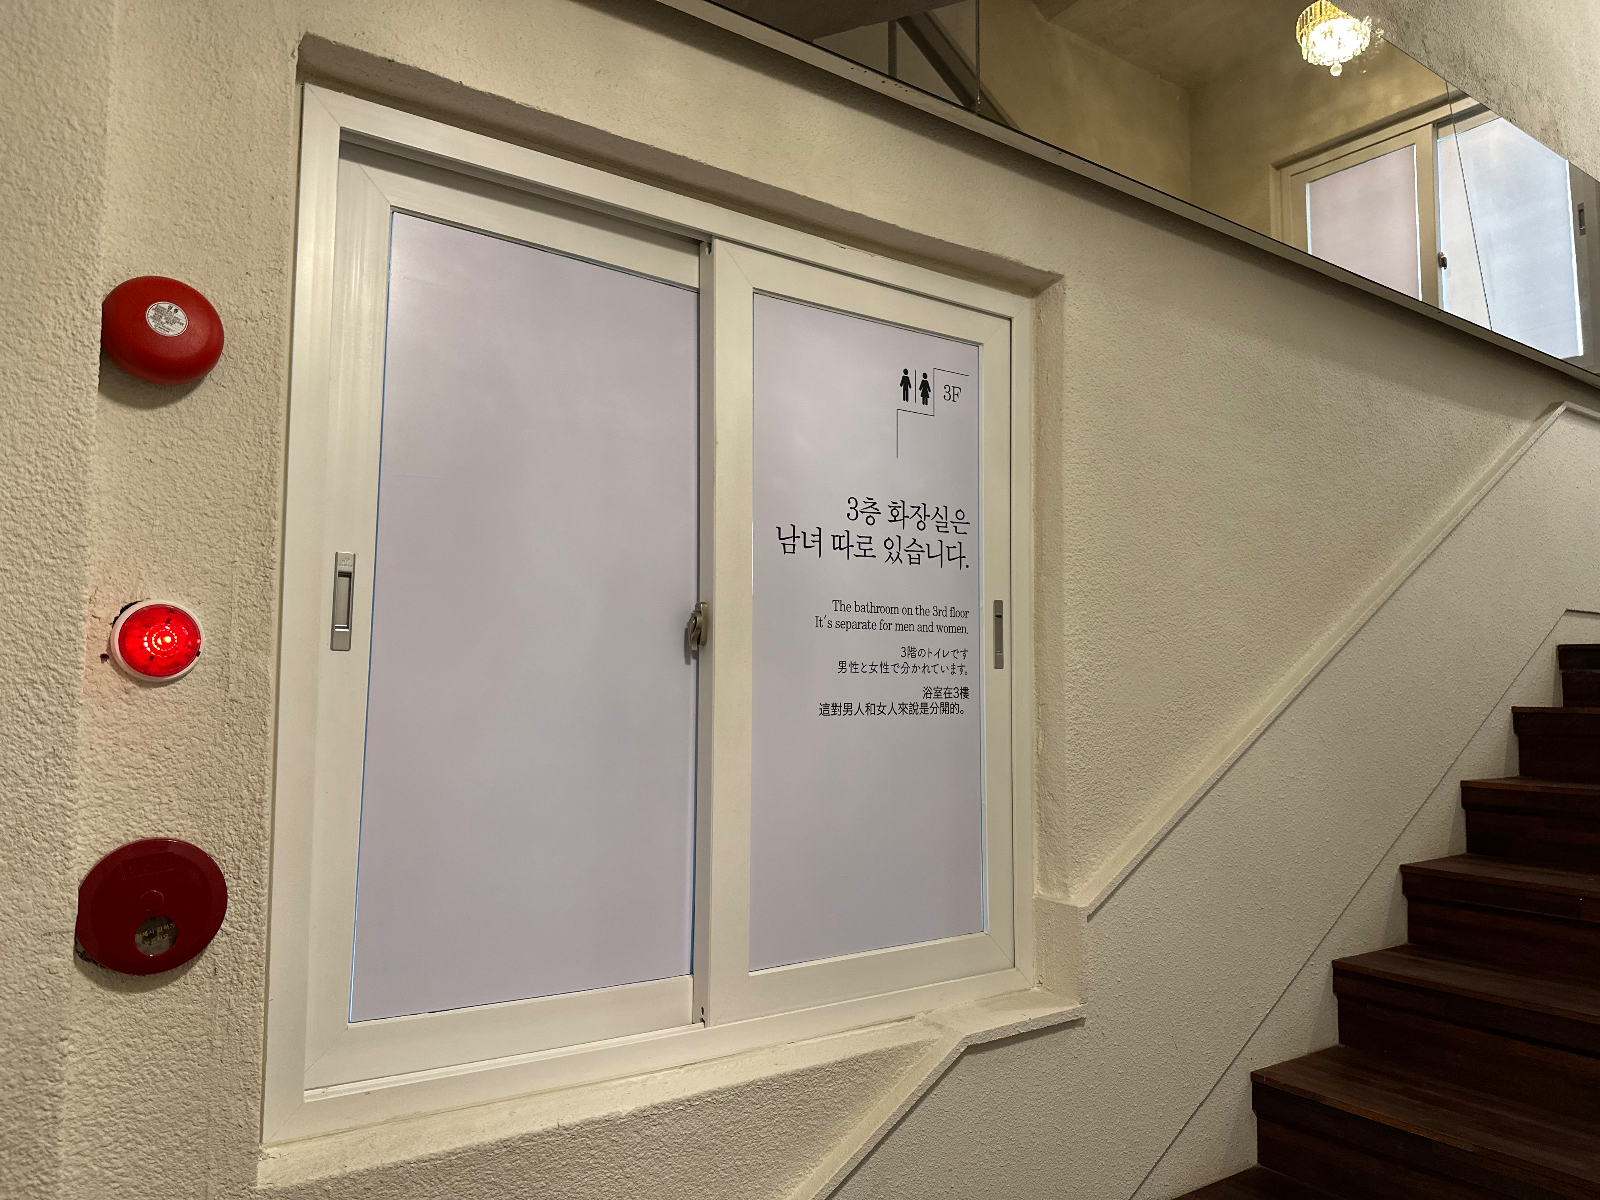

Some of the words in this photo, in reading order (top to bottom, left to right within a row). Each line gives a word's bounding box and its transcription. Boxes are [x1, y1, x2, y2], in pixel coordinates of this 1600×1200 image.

[943, 384, 962, 403] 3F
[846, 496, 882, 526] 3층
[887, 499, 971, 535] 화장실은
[775, 523, 822, 558] 남녀
[830, 529, 877, 560] 따로
[883, 534, 970, 570] 있습니다.
[831, 599, 852, 613] The
[853, 600, 900, 615] bathroom
[901, 606, 914, 616] on
[914, 604, 931, 617] the
[932, 605, 948, 618] 3rd
[949, 606, 970, 619] floor
[814, 615, 833, 629] It's
[834, 618, 877, 632] separate
[878, 618, 893, 632] for
[894, 622, 915, 633] men
[916, 621, 935, 634] and
[935, 624, 969, 635] women.
[900, 646, 969, 660] 3階のトイレです
[837, 660, 968, 676] 男性と女性で分かれています。
[922, 686, 970, 700] 浴室在3樓
[818, 702, 965, 717] 這對男人和女人來說是分開的。
